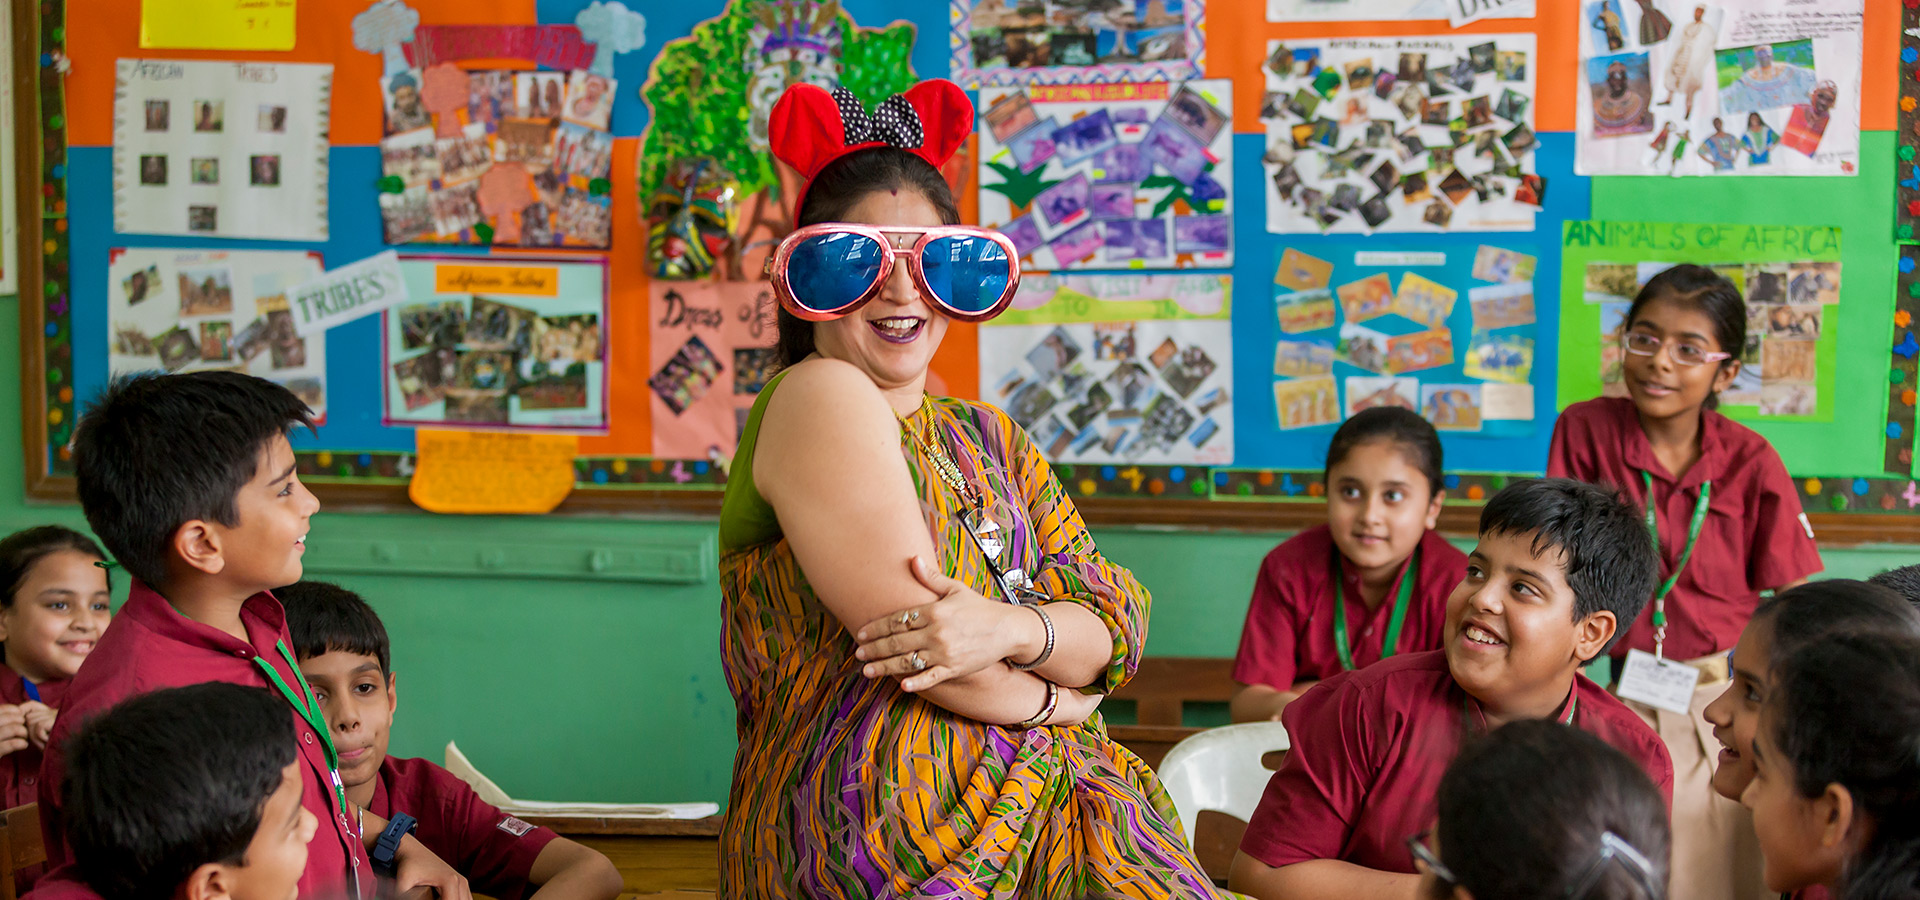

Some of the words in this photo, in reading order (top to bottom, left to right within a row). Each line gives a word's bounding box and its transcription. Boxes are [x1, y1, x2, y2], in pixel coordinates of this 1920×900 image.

[1566, 220, 1687, 250] ANIMALS
[1696, 225, 1734, 249] OF
[1742, 226, 1839, 256] AFRICA
[297, 269, 385, 323] TRIBES
[738, 290, 769, 338] of
